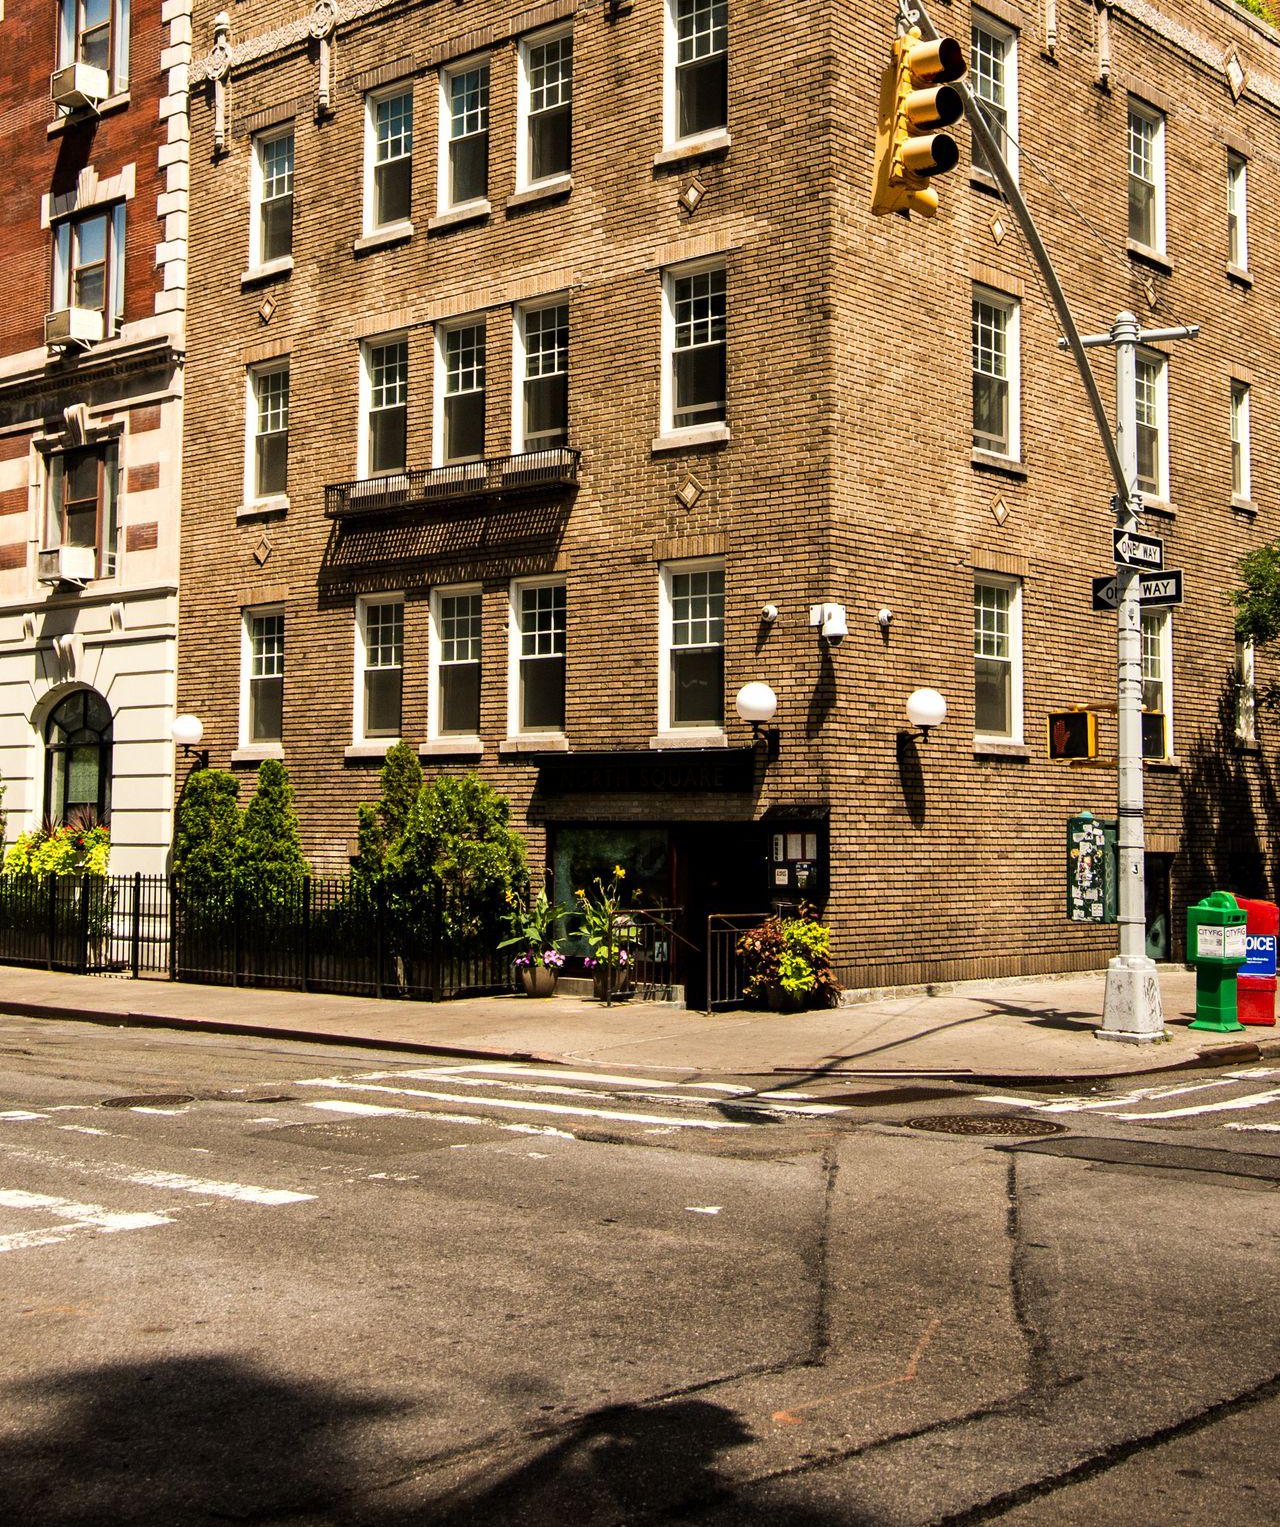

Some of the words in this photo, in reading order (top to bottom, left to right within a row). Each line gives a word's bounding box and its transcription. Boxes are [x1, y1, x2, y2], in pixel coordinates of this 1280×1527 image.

[1121, 541, 1137, 556] ONE
[1142, 546, 1158, 560] WAY
[1143, 581, 1170, 597] WAY
[640, 767, 726, 790] SQUARE
[1246, 937, 1273, 950] OICE
